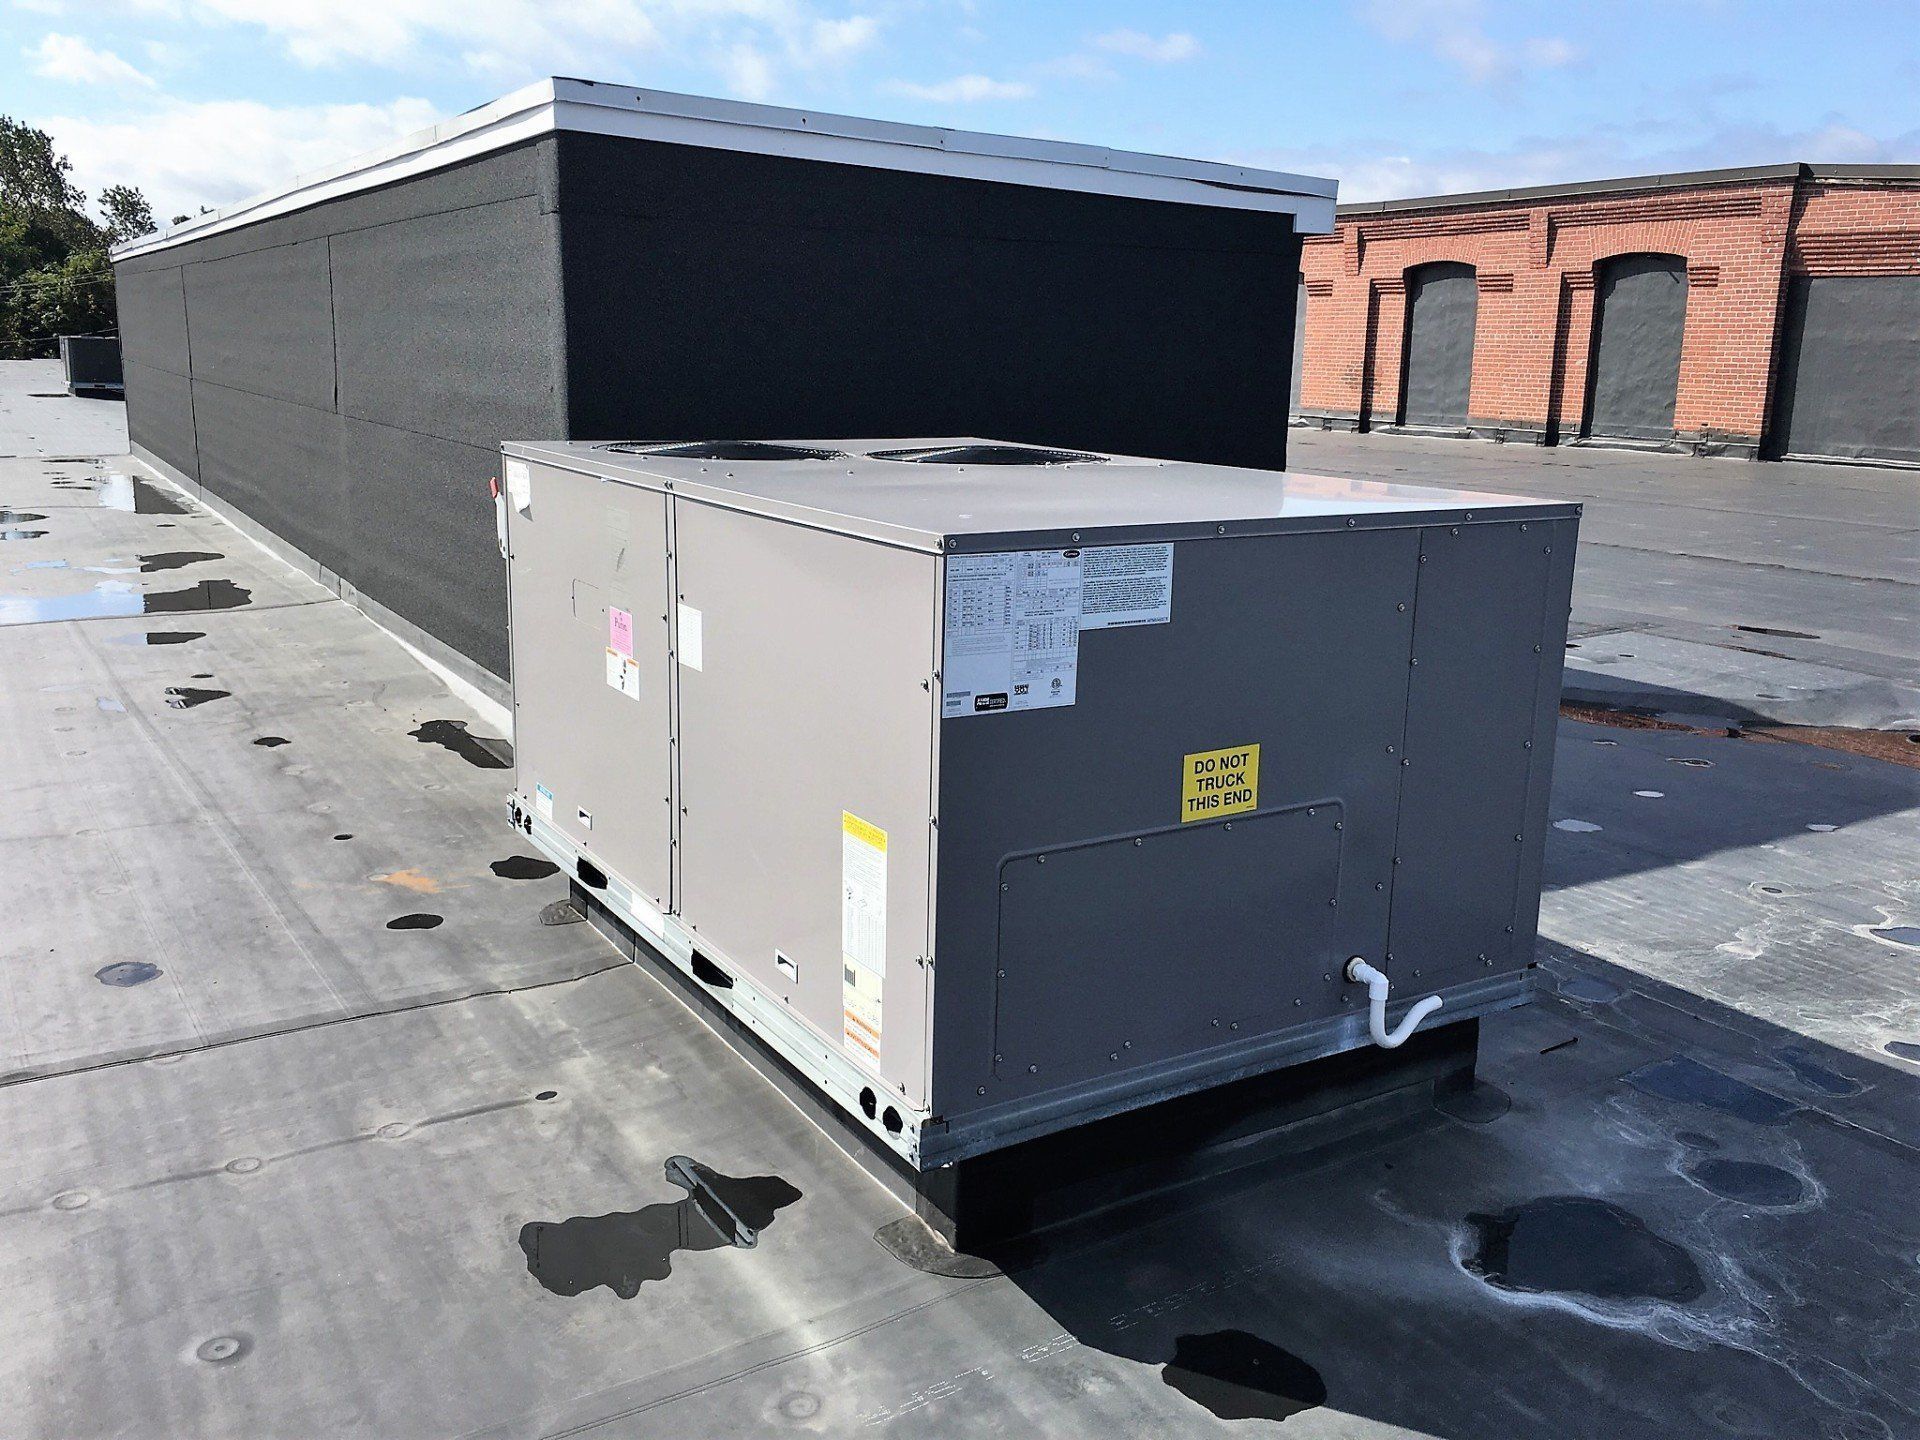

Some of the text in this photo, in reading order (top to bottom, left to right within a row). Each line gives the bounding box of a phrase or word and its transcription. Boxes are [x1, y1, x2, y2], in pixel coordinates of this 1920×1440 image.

[1194, 753, 1249, 774] DO NOT
[1196, 771, 1245, 792] TRUCK
[1188, 788, 1252, 811] THIS END
